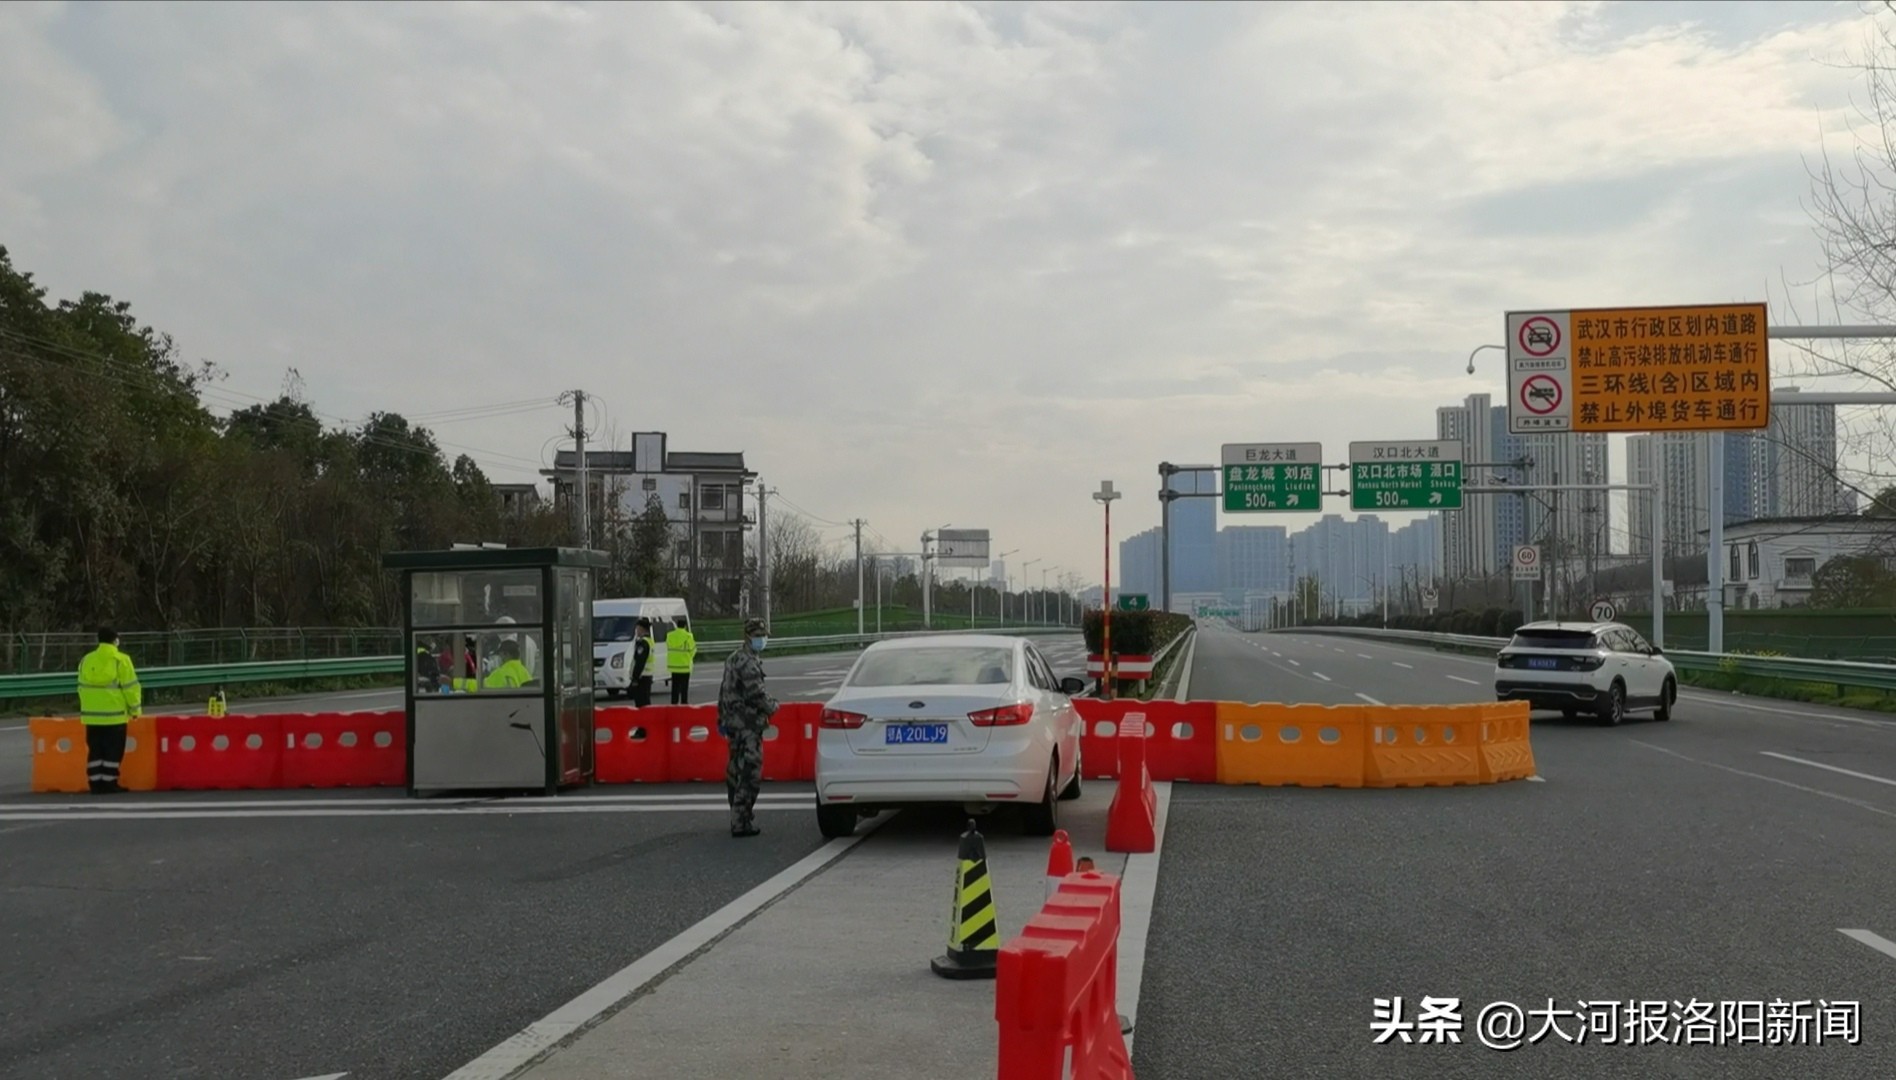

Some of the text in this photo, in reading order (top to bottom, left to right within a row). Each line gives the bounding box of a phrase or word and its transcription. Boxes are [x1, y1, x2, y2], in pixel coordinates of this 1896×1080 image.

[1578, 312, 1757, 340] 武汉市行政区划内道路
[1578, 341, 1758, 368] 禁止高污染排放机动车通行
[1579, 369, 1759, 395] 三环线(含)区域内
[1580, 398, 1760, 424] 禁止外埠货车通行
[1245, 448, 1297, 461] 巨龙大道
[1373, 446, 1440, 458] 汉口北大道
[1229, 465, 1313, 481] 盘龙城 刘店
[1357, 464, 1422, 479] 汉口北市场
[1229, 483, 1316, 492] Panlongcheng Liudian
[1381, 480, 1399, 488] North
[1400, 480, 1422, 488] Market
[1521, 551, 1532, 560] 60
[1129, 597, 1138, 606] 4
[1595, 606, 1612, 619] 70
